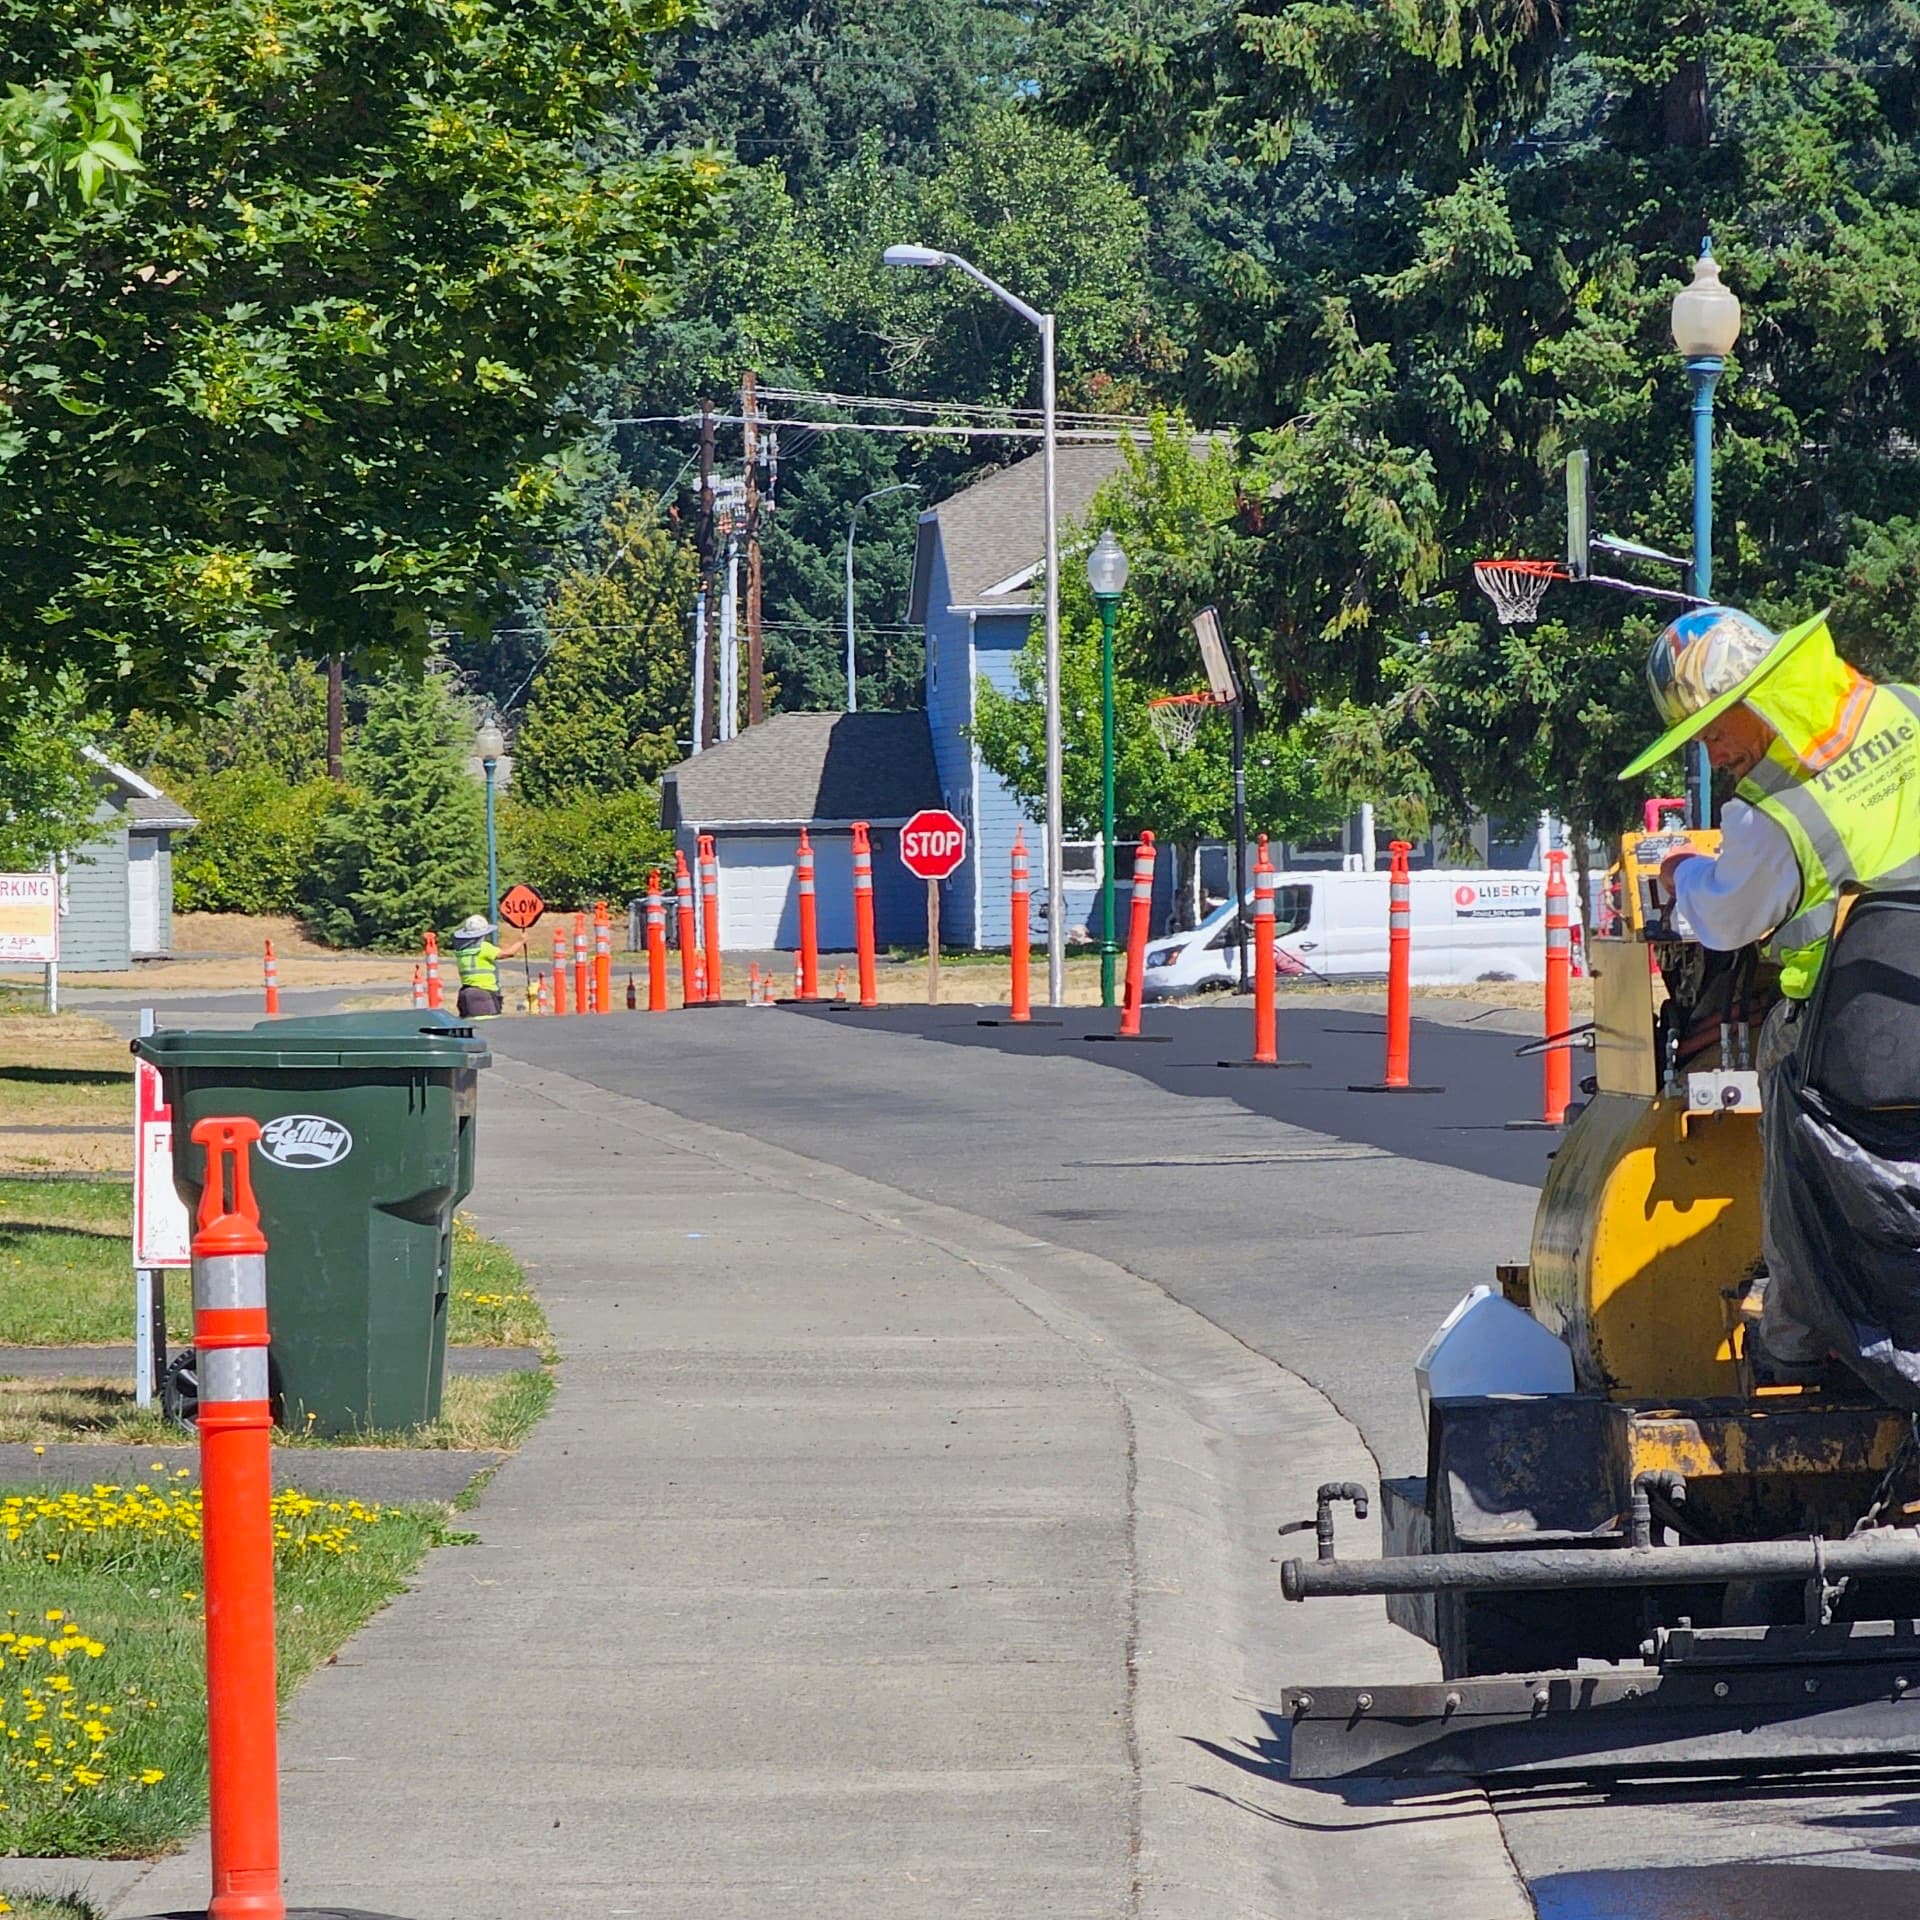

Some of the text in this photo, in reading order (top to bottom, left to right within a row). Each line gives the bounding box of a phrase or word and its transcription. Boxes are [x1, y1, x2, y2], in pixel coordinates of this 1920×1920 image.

[905, 830, 960, 857] STOP
[1480, 885, 1540, 897] LIBERTY
[505, 899, 537, 914] SLOW
